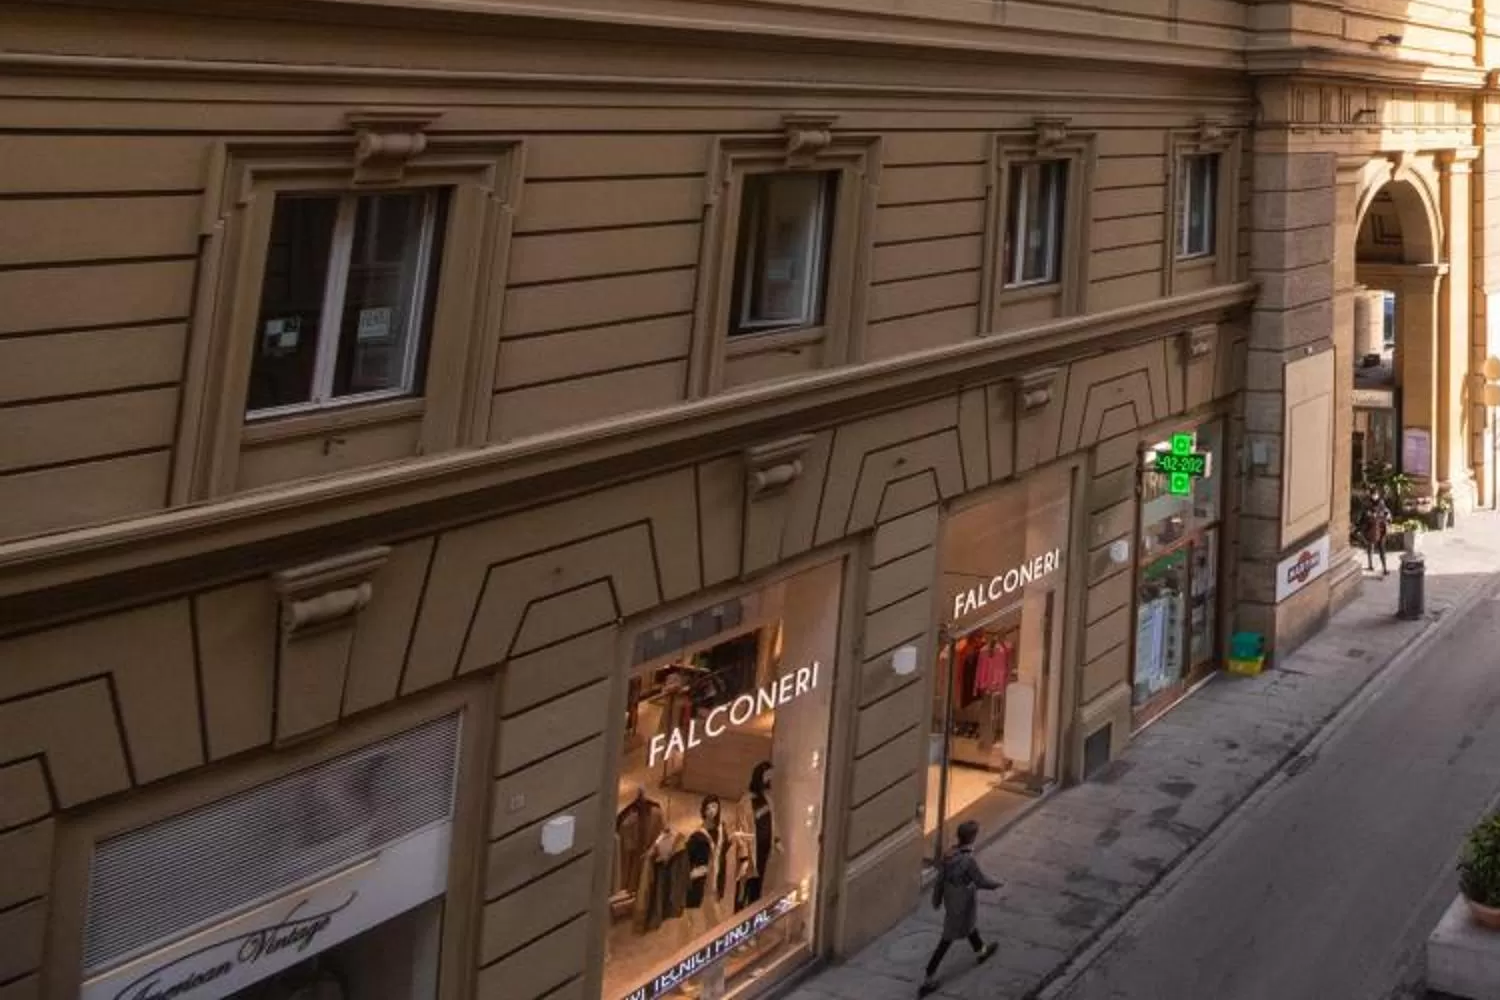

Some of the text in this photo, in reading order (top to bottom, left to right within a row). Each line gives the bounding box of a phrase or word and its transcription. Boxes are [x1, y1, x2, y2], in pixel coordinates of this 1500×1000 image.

[953, 547, 1060, 619] FALCONERI
[648, 660, 820, 768] FALCONERI
[237, 908, 331, 964] Vintage
